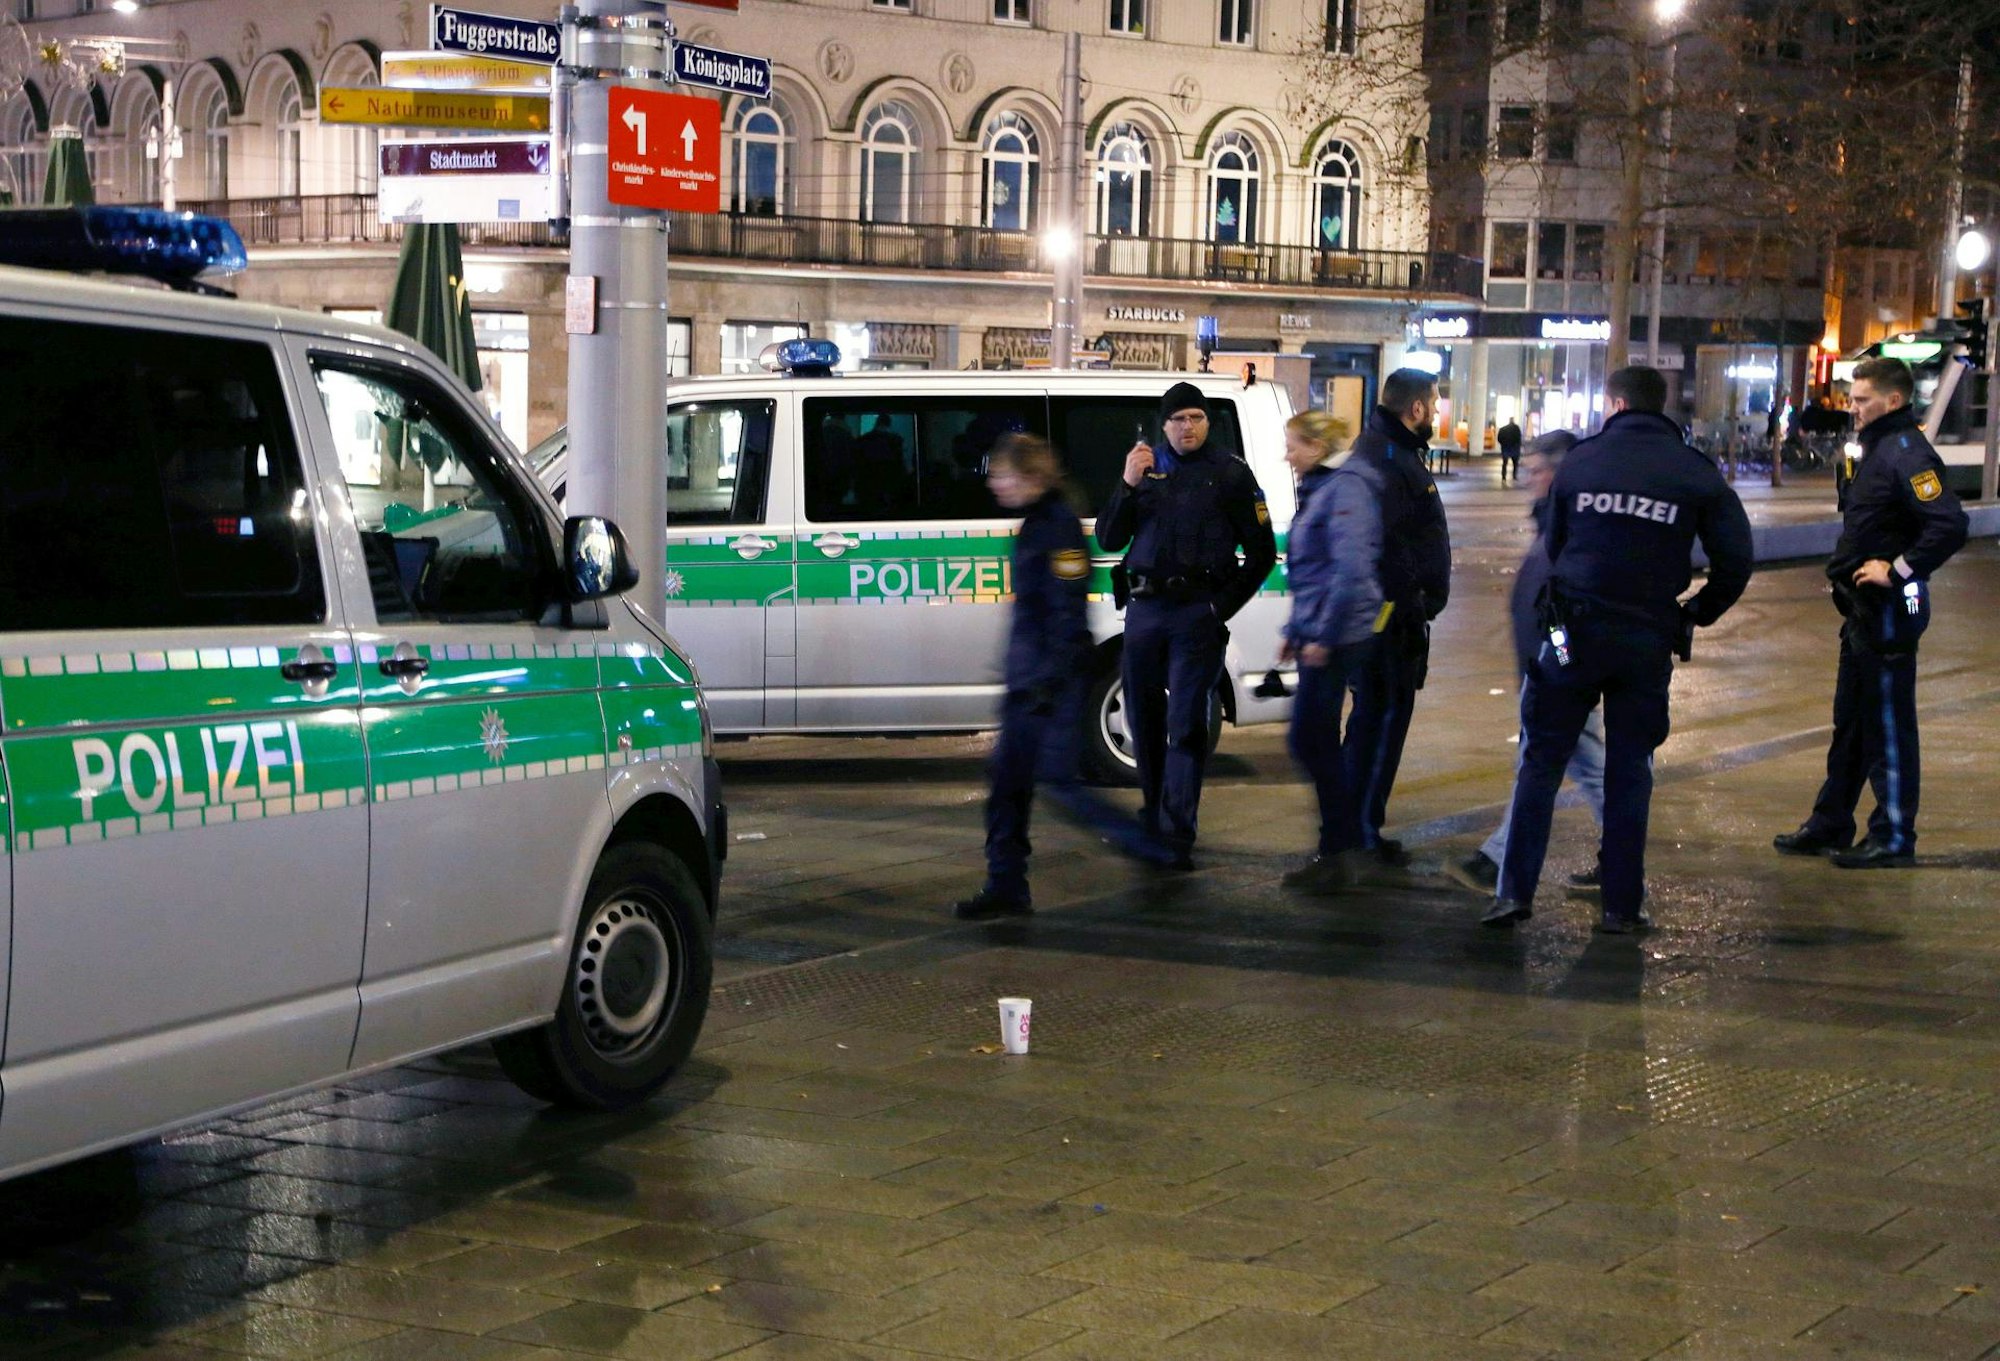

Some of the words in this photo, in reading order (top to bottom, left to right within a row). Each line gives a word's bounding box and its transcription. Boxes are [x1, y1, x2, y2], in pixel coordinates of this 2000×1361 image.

[443, 13, 557, 54] Fuggerstraße
[433, 64, 520, 80] Planetarium
[683, 48, 766, 88] Königsplatz
[367, 97, 509, 121] Naturmuseum
[430, 150, 497, 169] Stadtmarkt
[1108, 306, 1186, 322] STARBUCKS
[1576, 492, 1679, 525] POLIZEI
[850, 556, 1012, 597] POLIZEI
[72, 720, 305, 821] POLIZEI
